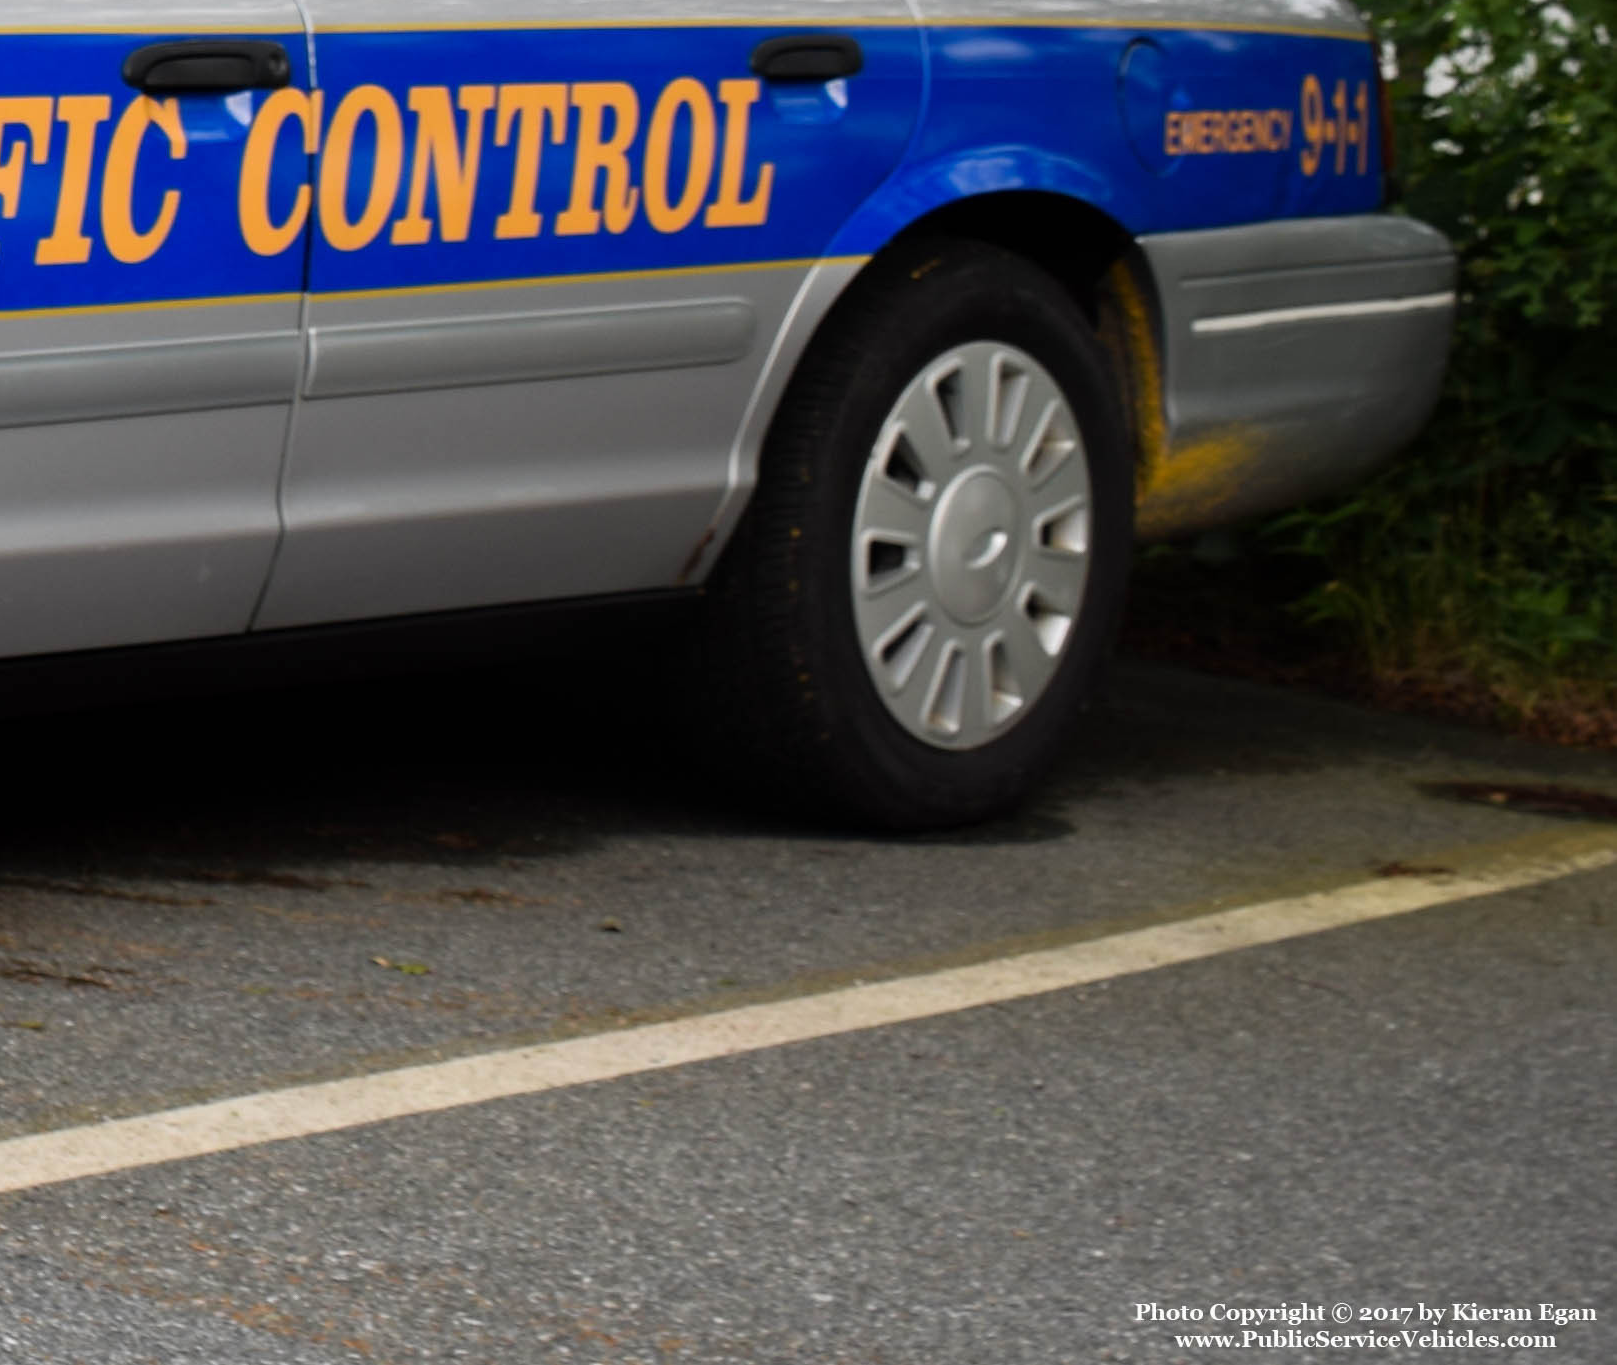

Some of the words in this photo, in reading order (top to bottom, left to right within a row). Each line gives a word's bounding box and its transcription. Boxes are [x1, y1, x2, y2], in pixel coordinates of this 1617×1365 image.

[238, 79, 771, 256] CONTROL
[1165, 110, 1292, 155] EMERGENCY
[1301, 74, 1369, 176] 9-1-1
